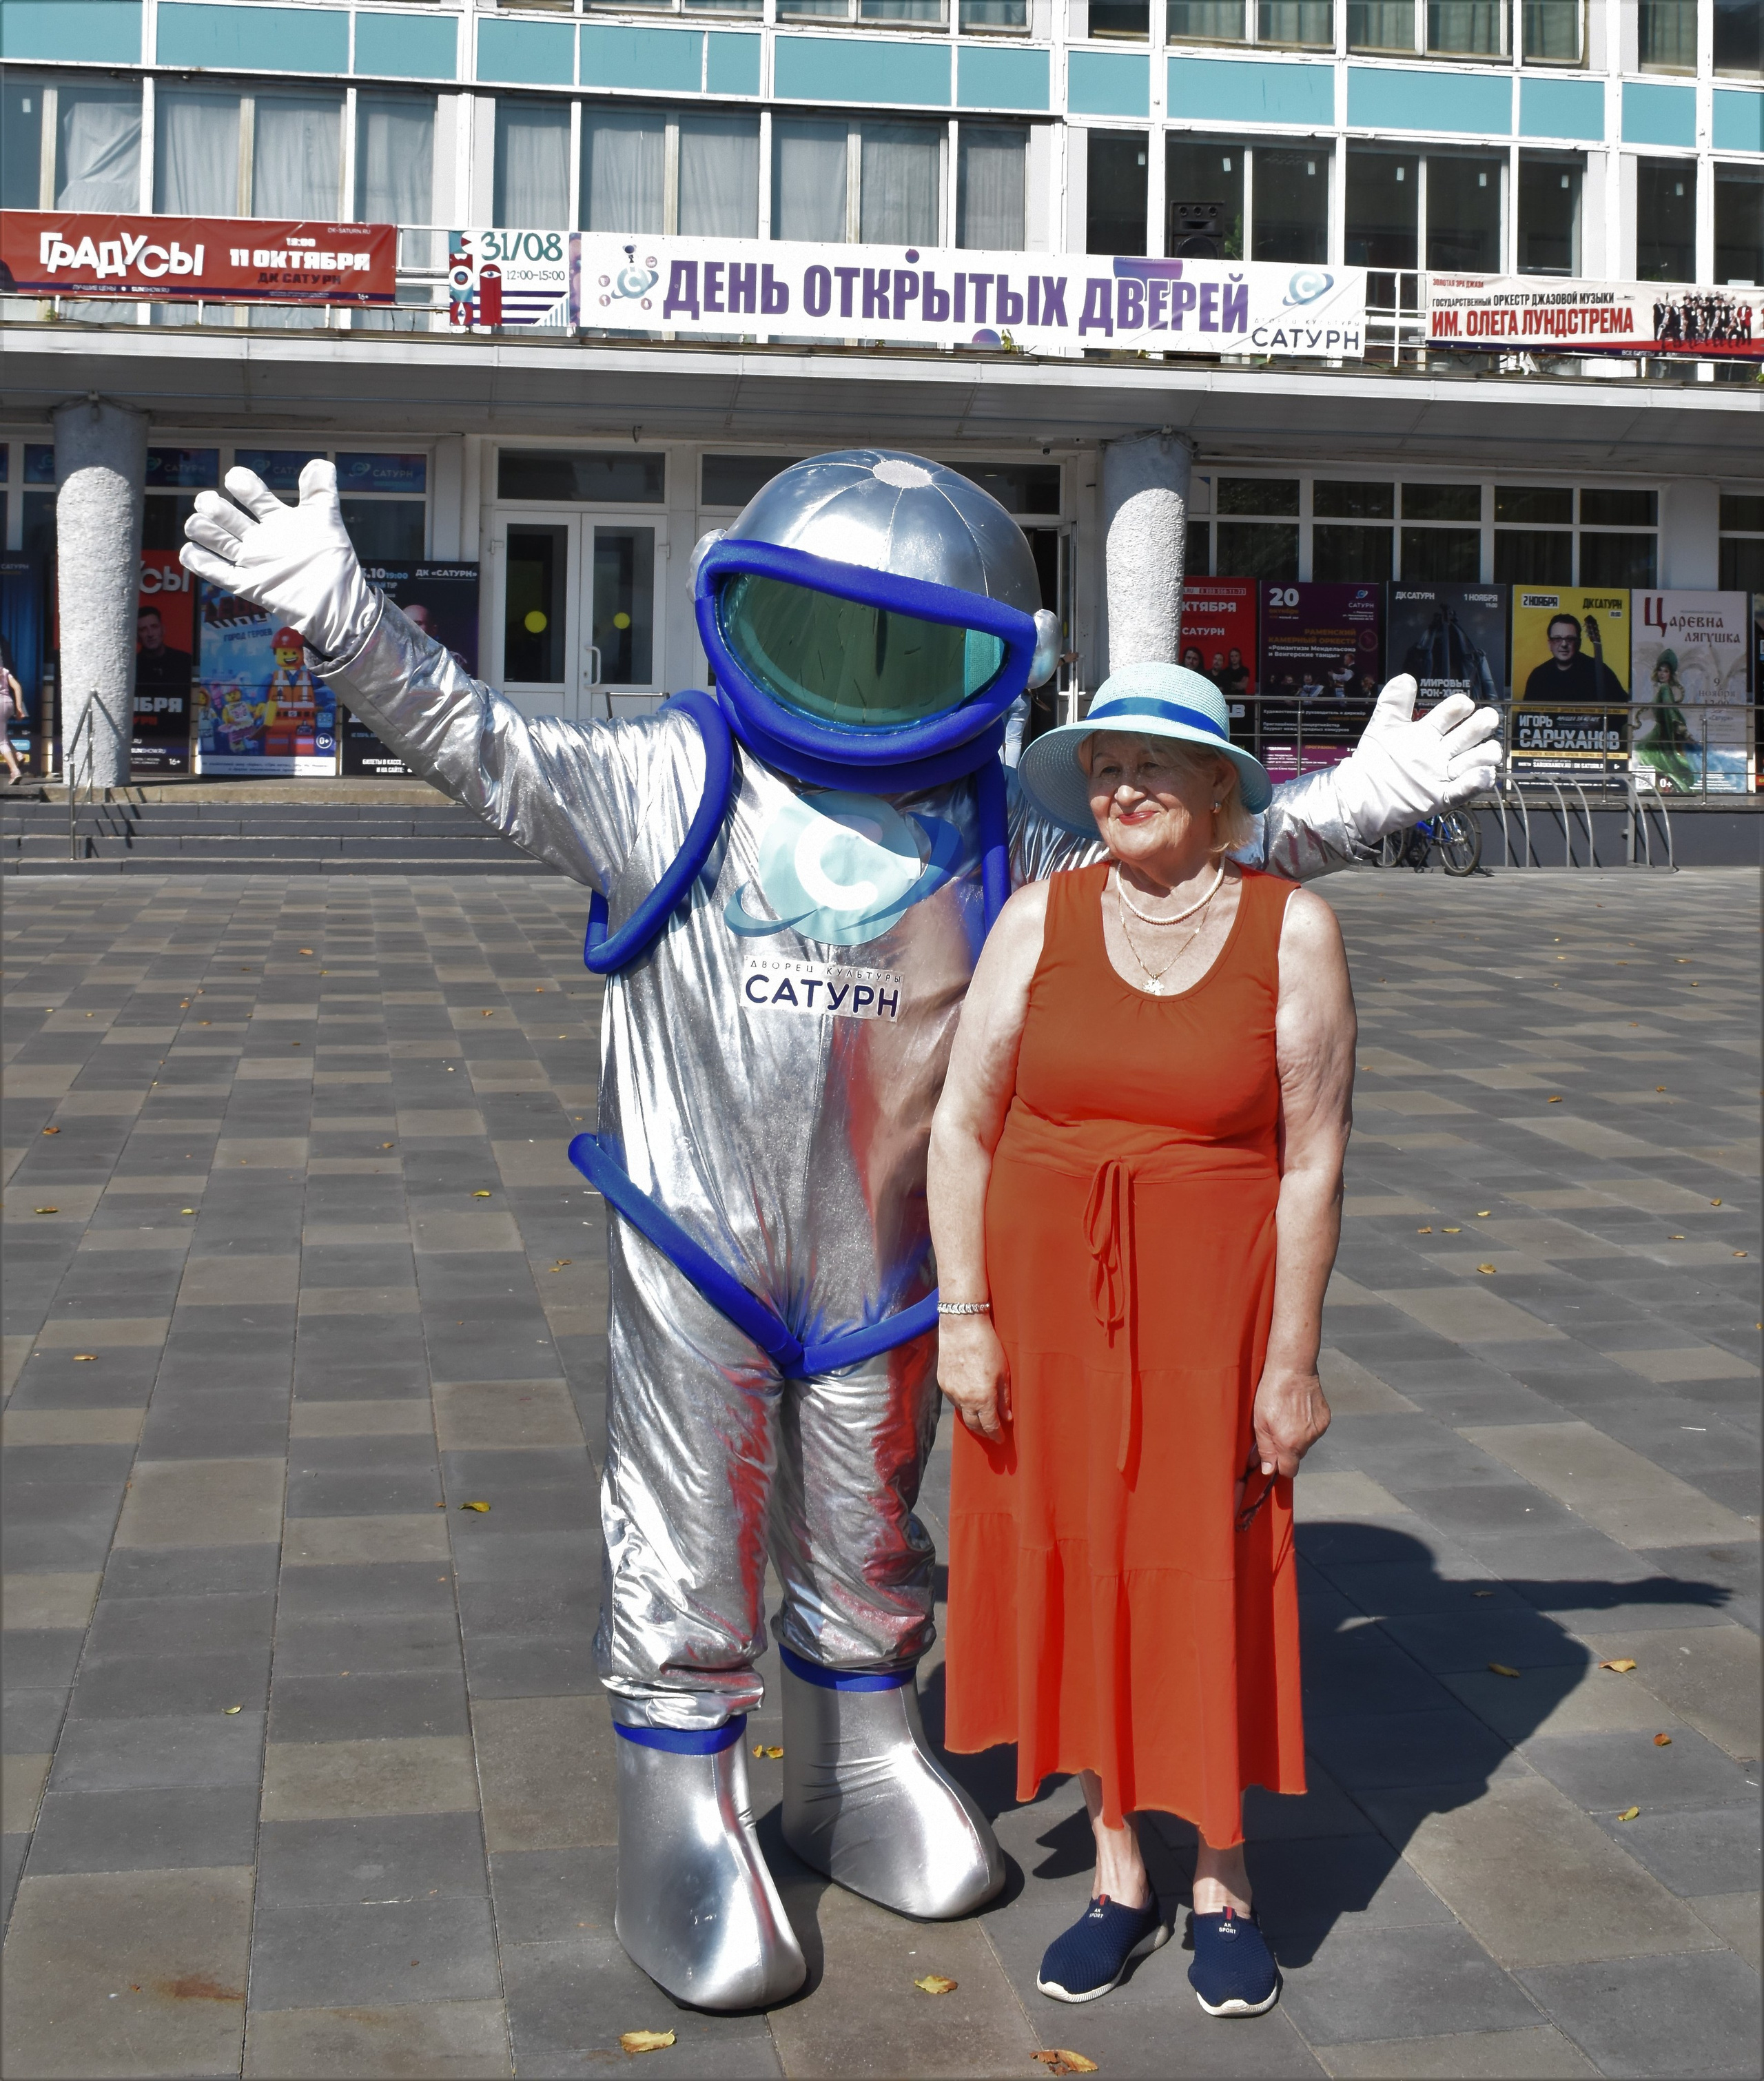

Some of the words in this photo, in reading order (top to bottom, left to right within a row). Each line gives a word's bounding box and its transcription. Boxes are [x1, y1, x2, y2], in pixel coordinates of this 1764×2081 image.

[286, 237, 316, 247] 19:00
[480, 232, 563, 261] 31/08
[229, 249, 249, 267] 11
[253, 249, 371, 271] ОКТЯБРЯ
[257, 272, 278, 284] ДК
[283, 274, 341, 285] САТУРН
[506, 269, 565, 281] 12:00-15:00
[1433, 278, 1455, 287] ЗОЛОТАЯ
[1466, 280, 1484, 289] ДЖАЗА
[663, 259, 790, 320] ДЕНЬ
[803, 265, 1069, 327] ОТКРЫТЫХ
[1078, 271, 1249, 338] ДВЕРЕЙ
[1433, 296, 1492, 307] ГОСУДАРСТВЕННЫЙ
[1493, 294, 1530, 307] ОРКЕСТР
[1532, 291, 1578, 307] ДЖАЗОВОЙ
[1579, 292, 1614, 305] МУЗЫКИ
[1432, 311, 1462, 337] ИМ.
[1466, 309, 1519, 336] ОЛЕГА
[1521, 307, 1634, 338] ЛУНДСТРЕМА
[1251, 327, 1359, 350] САТУРН
[273, 467, 300, 475] САТУ
[372, 469, 413, 478] САТУРН
[138, 561, 192, 593] СЫ
[1269, 588, 1300, 606] 20
[1395, 591, 1406, 600] ДК
[1407, 592, 1435, 600] САТУРН
[1524, 595, 1528, 606] 2
[1528, 596, 1558, 607] НОЯБРЯ
[1182, 601, 1237, 613] КТЯБРЯ
[1583, 598, 1594, 609] ДК
[1594, 599, 1623, 609] САТУРН
[224, 633, 246, 642] ГОРОД
[247, 628, 272, 639] ГЕРОЕВ
[1182, 627, 1225, 635] САТУРН
[1419, 679, 1470, 688] МИРОВЫЕ
[1714, 678, 1721, 686] 9
[1699, 688, 1736, 700] ноября
[1519, 715, 1553, 727] ИГОРЬ
[1519, 728, 1620, 750] САРУХАНОВ
[1659, 778, 1673, 788] 0+
[750, 960, 813, 973] ДВОРЕЦ
[826, 967, 901, 983] КУЛЬТУРЫ
[746, 974, 899, 1018] САТУРН
